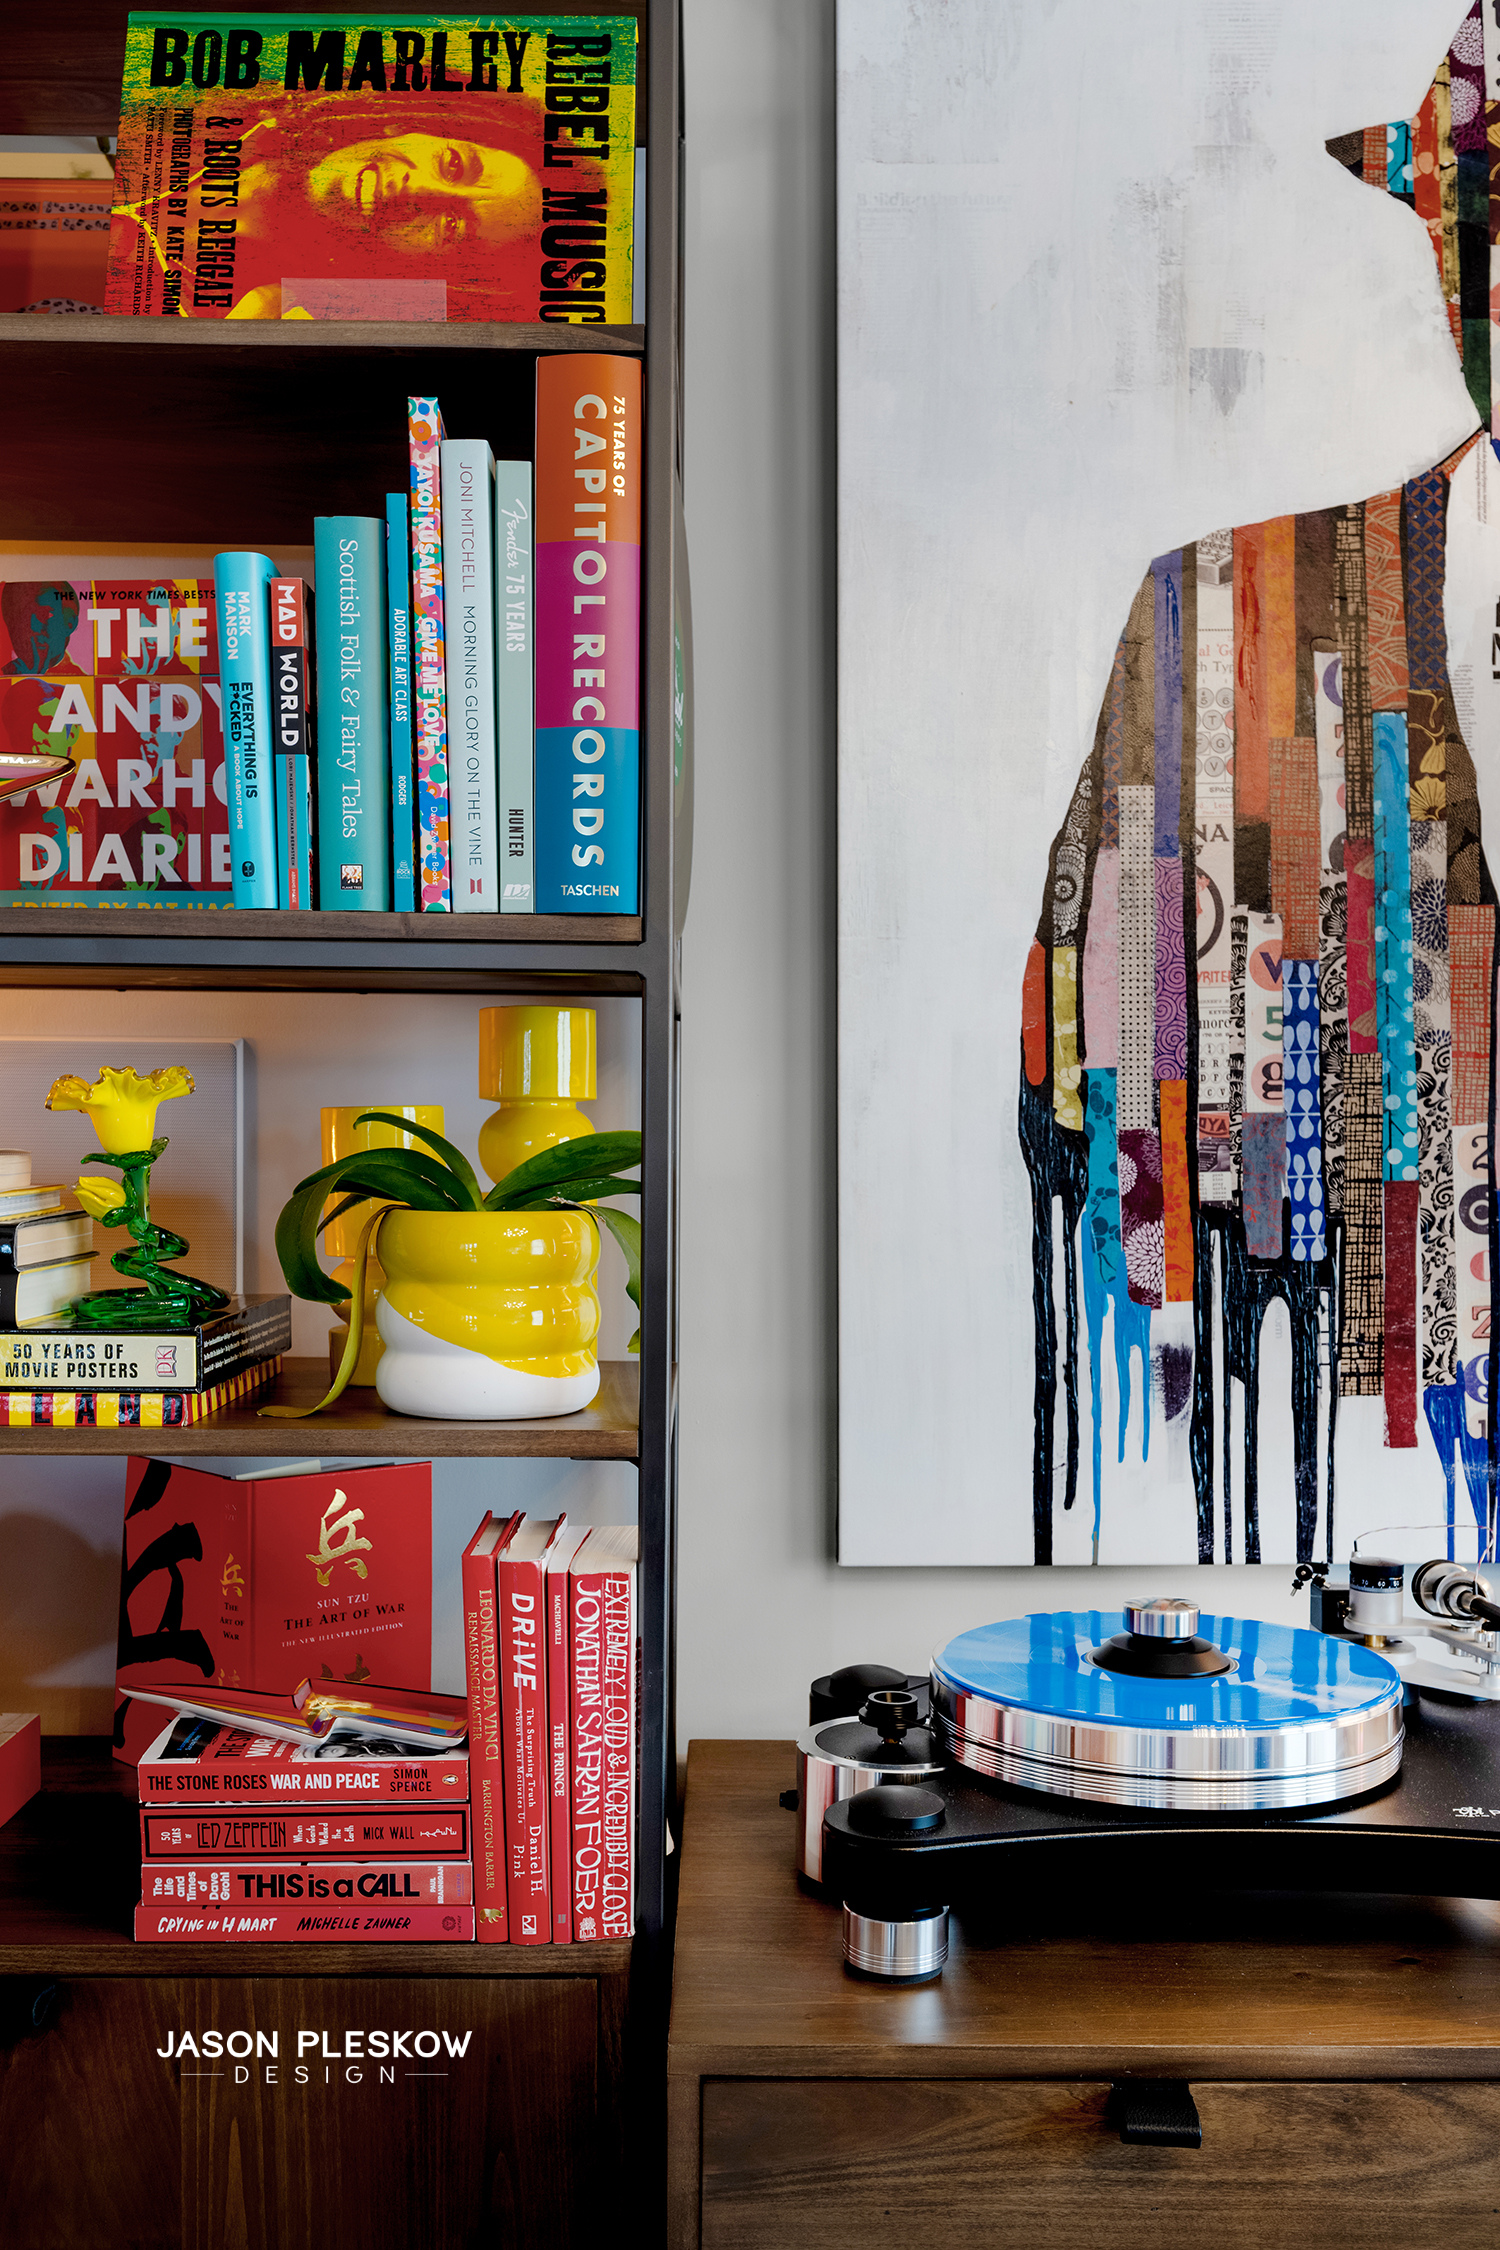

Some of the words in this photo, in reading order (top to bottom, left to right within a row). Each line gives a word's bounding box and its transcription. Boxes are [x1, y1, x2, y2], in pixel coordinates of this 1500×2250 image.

[150, 27, 263, 90] BOB
[284, 31, 531, 93] MARLEY
[544, 34, 612, 167] REBEL
[205, 116, 243, 129] &
[168, 107, 194, 193] PHOTOGRAPHS
[153, 161, 163, 194] LENNY
[200, 138, 243, 208] ROOTS
[167, 198, 188, 218] BY
[165, 226, 185, 261] KATE
[193, 218, 237, 308] REGGAE
[539, 188, 607, 323] MUSIC
[132, 261, 143, 316] RICHARDS
[144, 246, 156, 302] Introduction
[162, 269, 182, 315] SIMON
[613, 395, 626, 414] 75
[613, 420, 626, 470] YEARS
[416, 456, 435, 512] YAYOI
[459, 462, 473, 502] JONI
[612, 474, 626, 497] OF
[573, 394, 607, 614] CAPITOL
[461, 508, 475, 593] MITCHELL
[501, 498, 529, 568] Fender
[417, 517, 438, 599] KUSAMA
[53, 591, 75, 601] THE
[79, 591, 105, 600] NEW
[110, 590, 142, 600] YORK
[146, 590, 180, 600] TIMES
[339, 539, 362, 626] Scottish
[506, 574, 525, 594] 75
[86, 607, 208, 659] THE
[224, 592, 239, 660] MANSON
[238, 592, 252, 637] MARK
[278, 585, 297, 641] MAD
[505, 601, 526, 652] YEARS
[394, 608, 407, 662] ADORABLE
[421, 617, 438, 662] GIVE
[463, 605, 478, 689] MORNING
[340, 634, 361, 681] Folk
[394, 666, 407, 686] ART
[278, 652, 299, 747] WORLD
[340, 687, 360, 708] &
[422, 666, 438, 694] ME
[395, 689, 408, 721] CLASS
[423, 698, 440, 746] LOVE
[464, 695, 479, 752] GLORY
[241, 682, 256, 781] EVERYTHING
[336, 715, 361, 773] Fairy
[572, 634, 606, 867] RECORDS
[398, 775, 407, 805] RODGERS
[466, 757, 480, 783] ON
[246, 785, 258, 799] IS
[341, 779, 363, 838] Tales
[467, 788, 481, 821] THE
[236, 808, 244, 830] HOPE
[508, 808, 524, 857] HUNTER
[19, 833, 234, 883] DIARIE
[469, 827, 482, 865] VINE
[560, 885, 619, 897] TASCHEN
[5, 1362, 58, 1378] MOVIE
[67, 1362, 139, 1379] POSTERS
[13, 1344, 32, 1359] 50
[41, 1343, 95, 1359] YEARS
[104, 1344, 124, 1359] OF
[156, 1349, 174, 1375] DK
[305, 1488, 373, 1587] 兵
[283, 1618, 313, 1630] THE
[319, 1612, 347, 1625] ART
[353, 1608, 370, 1620] OF
[375, 1603, 405, 1615] WAR
[317, 1598, 340, 1609] SUN
[347, 1593, 369, 1604] TZU
[554, 1594, 562, 1645] MACHIAVELLI
[468, 1612, 481, 1692] RENAISSANCE
[479, 1589, 496, 1682] LEONARDO
[511, 1592, 537, 1691] DRiVE
[575, 1580, 602, 1707] JONATHAN
[604, 1578, 630, 1691] EXTREMELY
[470, 1694, 482, 1742] MASTER
[483, 1685, 497, 1710] DA
[526, 1708, 535, 1726] The
[484, 1712, 499, 1761] VINCI
[515, 1708, 523, 1737] About
[554, 1723, 564, 1749] THE
[604, 1695, 628, 1749] LOUD
[516, 1739, 524, 1763] What
[526, 1729, 535, 1777] Surprising
[575, 1711, 602, 1815] SAFRAN
[606, 1751, 628, 1769] &
[147, 1776, 173, 1791] THE
[176, 1775, 219, 1790] STONE
[223, 1774, 267, 1790] ROSES
[270, 1774, 302, 1789] WAR
[304, 1774, 332, 1789] AND
[336, 1773, 380, 1788] PEACE
[389, 1781, 432, 1793] SPENCE
[393, 1768, 428, 1780] SIMON
[516, 1766, 524, 1809] Motivates
[528, 1781, 536, 1808] Truth
[554, 1752, 564, 1797] PRINCE
[318, 1822, 328, 1846] Walked
[363, 1826, 385, 1840] MICK
[389, 1826, 414, 1840] WALL
[482, 1779, 494, 1849] BARRINGTON
[517, 1812, 525, 1824] Us
[604, 1771, 630, 1872] INCREDIBLY
[161, 1831, 171, 1841] 50
[197, 1823, 221, 1848] LED
[224, 1822, 286, 1848] ZEPPELIN
[529, 1825, 542, 1878] Daniel
[484, 1851, 495, 1891] BARBER
[513, 1844, 525, 1879] Pink
[575, 1820, 602, 1914] FOER
[152, 1877, 164, 1897] The
[164, 1877, 174, 1896] Life
[176, 1875, 186, 1898] and
[186, 1871, 197, 1901] Times
[199, 1880, 208, 1892] of
[209, 1872, 219, 1900] Dave
[220, 1872, 230, 1901] Grohl
[237, 1873, 304, 1898] THIS
[307, 1874, 329, 1898] is
[333, 1877, 354, 1897] a
[357, 1873, 420, 1897] CALL
[530, 1881, 543, 1896] H.
[602, 1875, 629, 1936] CLOSE
[157, 1916, 204, 1933] CRYING
[206, 1919, 220, 1931] IN
[222, 1916, 237, 1933] H
[237, 1917, 277, 1932] MART
[296, 1917, 359, 1932] MICHELLE
[363, 1917, 411, 1930] ZAUNER
